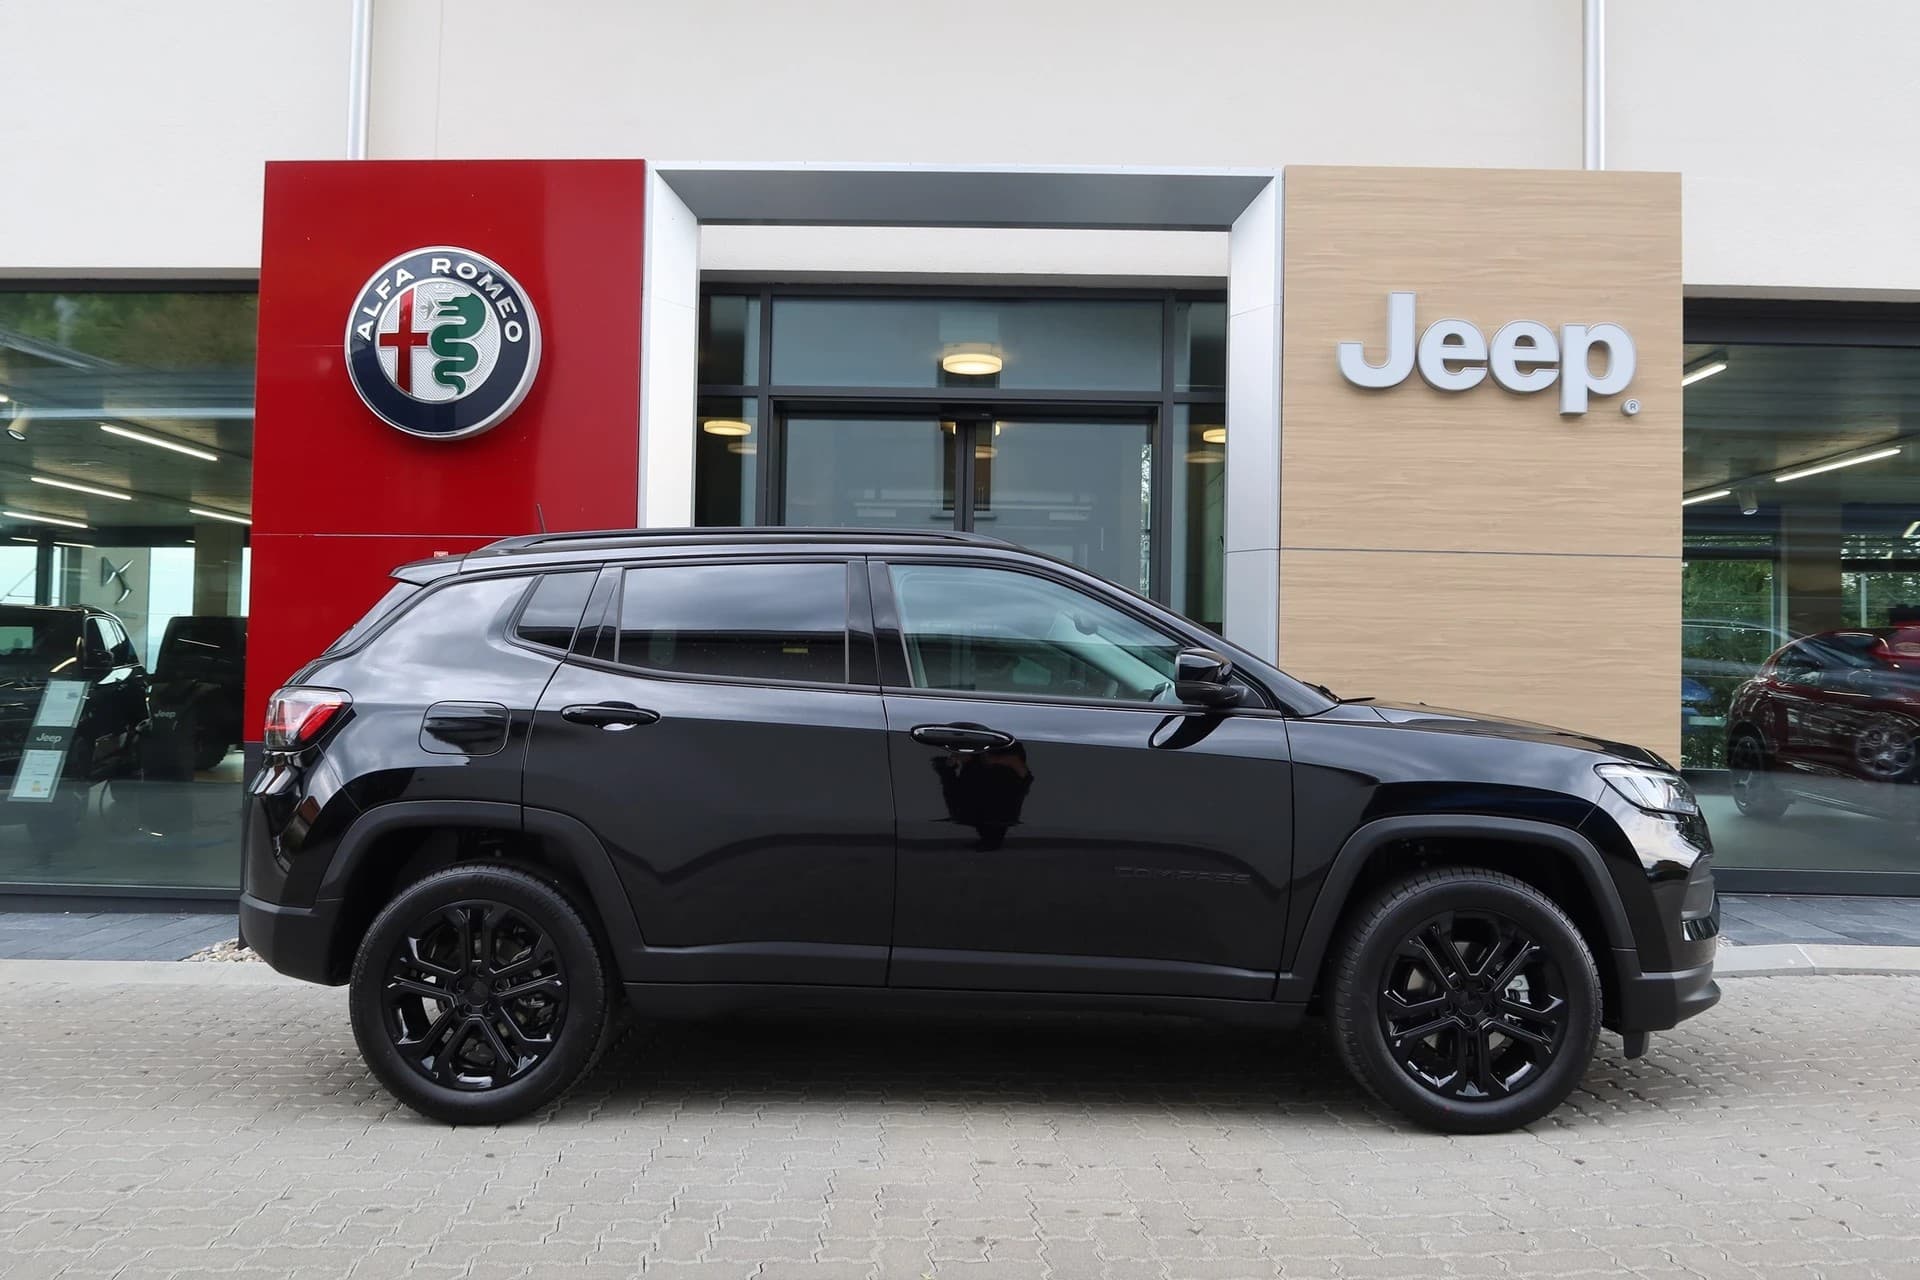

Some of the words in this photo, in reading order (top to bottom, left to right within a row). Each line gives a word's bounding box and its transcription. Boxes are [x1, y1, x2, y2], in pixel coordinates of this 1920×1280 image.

[357, 268, 415, 341] ALFA
[431, 258, 523, 343] ROMEO
[1337, 291, 1636, 415] Jeep
[36, 732, 62, 744] Jeep
[154, 710, 176, 719] Jeep
